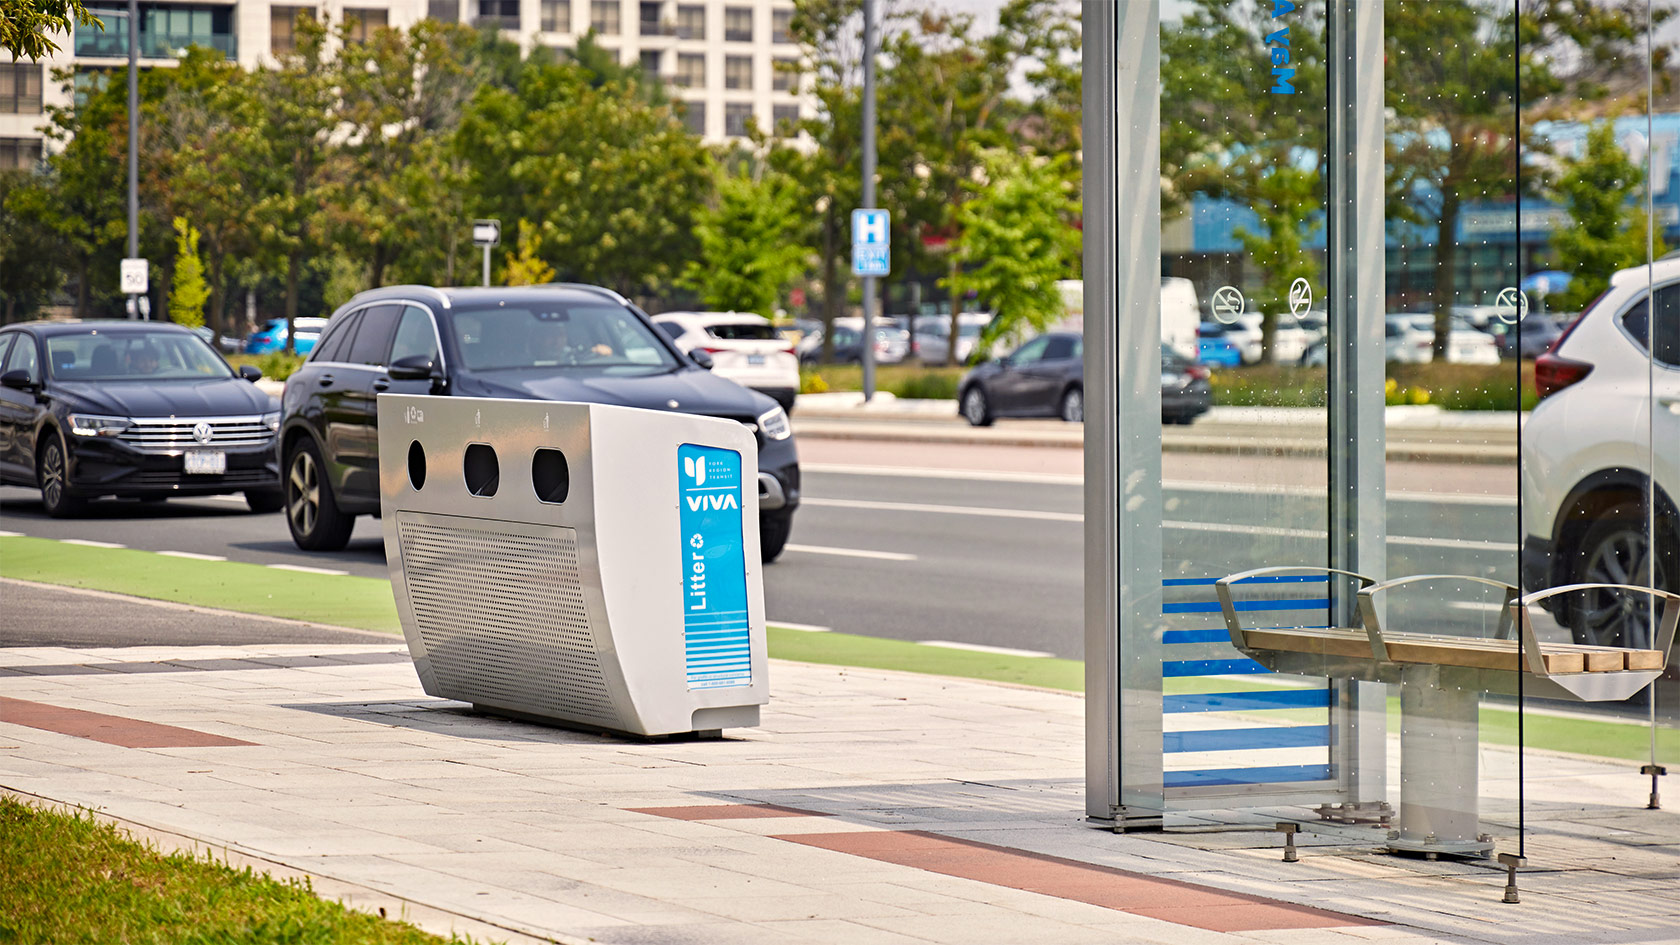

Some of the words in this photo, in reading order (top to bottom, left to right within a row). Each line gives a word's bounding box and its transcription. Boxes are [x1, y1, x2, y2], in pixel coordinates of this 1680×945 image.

[859, 213, 886, 243] H
[126, 271, 145, 287] 50
[685, 493, 739, 512] VIVA
[689, 551, 707, 611] Litter
